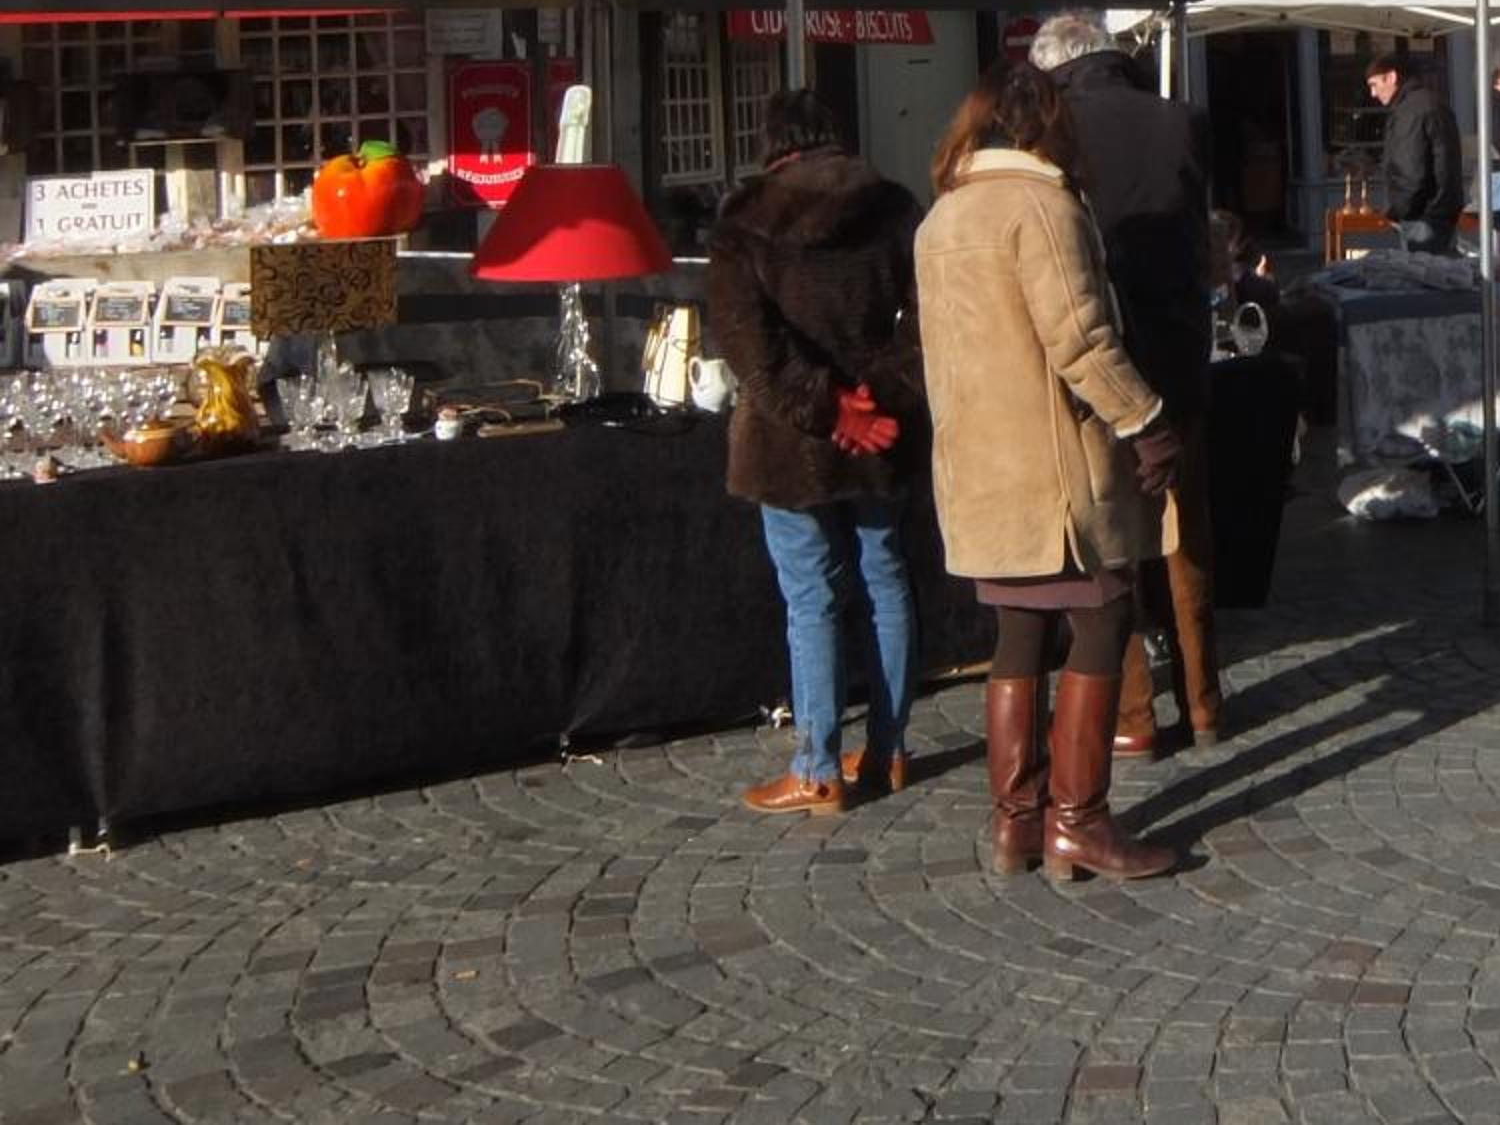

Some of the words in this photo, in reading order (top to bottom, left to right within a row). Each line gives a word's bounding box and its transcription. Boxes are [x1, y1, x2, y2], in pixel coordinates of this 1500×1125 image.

[34, 184, 46, 201] 3
[55, 178, 144, 200] ACHETES
[57, 212, 144, 234] GRATUIT
